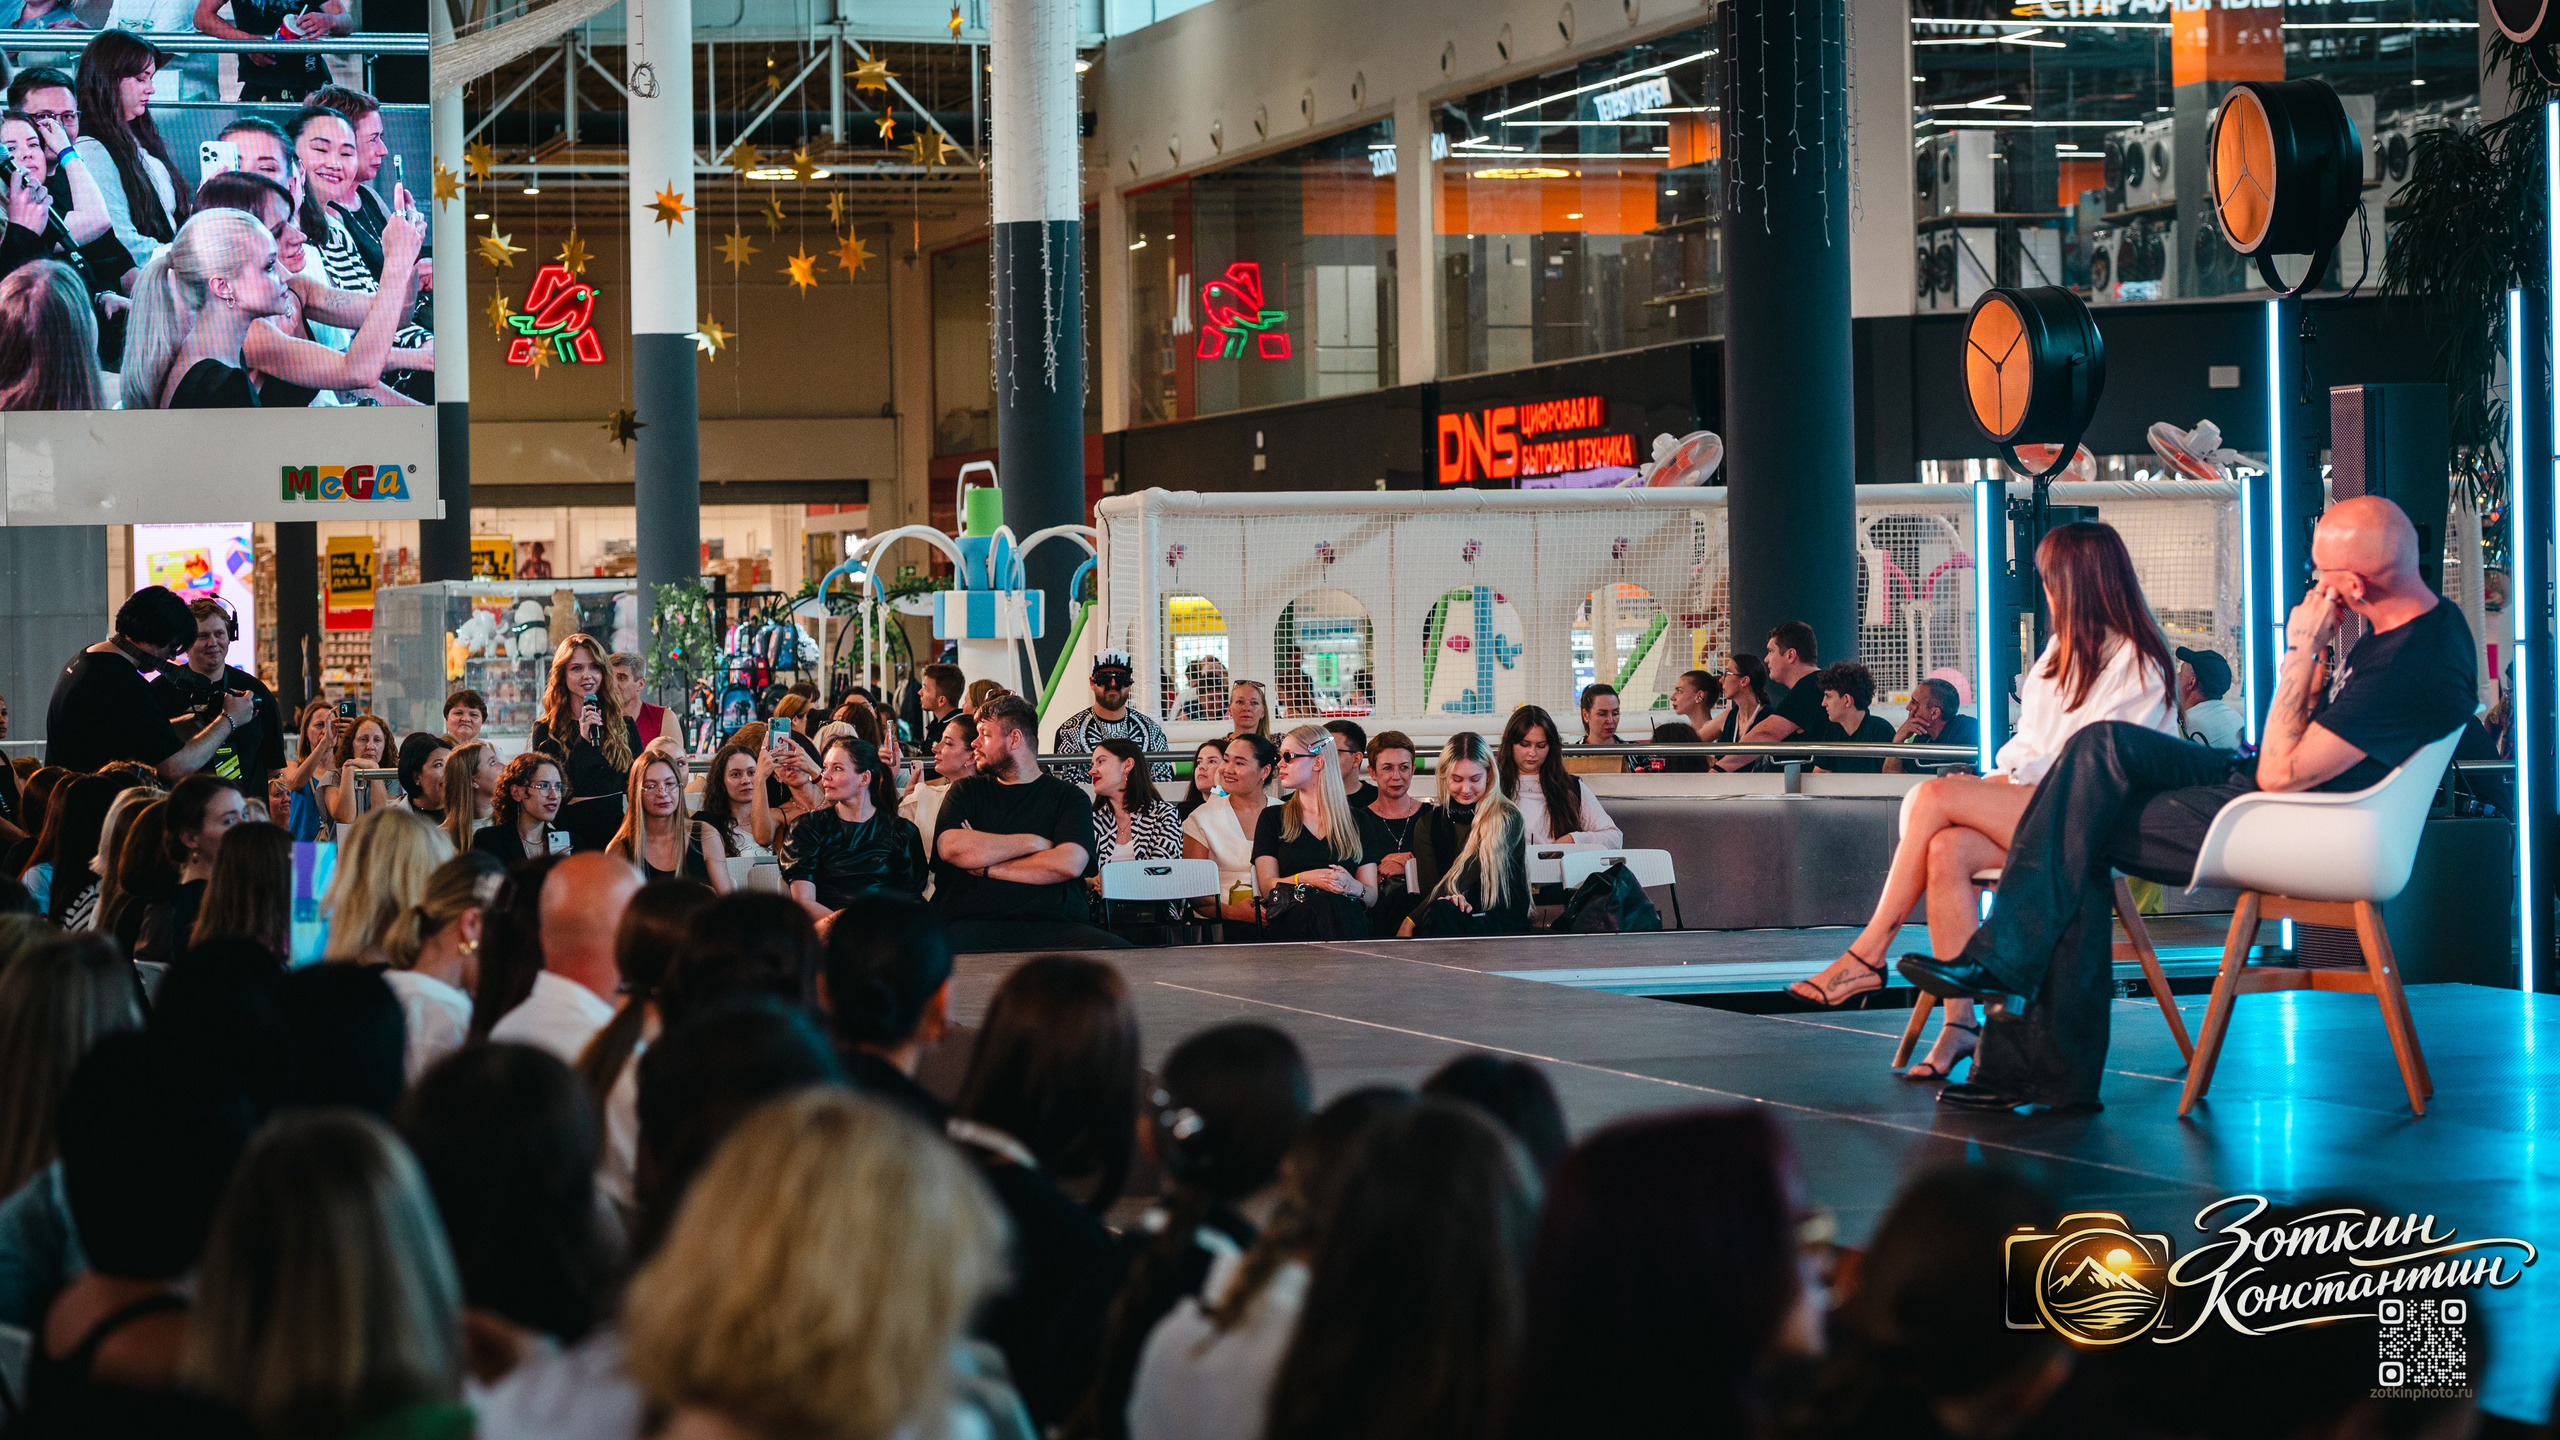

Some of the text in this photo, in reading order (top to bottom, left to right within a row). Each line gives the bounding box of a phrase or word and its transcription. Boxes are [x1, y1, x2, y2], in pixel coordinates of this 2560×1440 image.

[1520, 396, 1599, 438] ЦИФРОВАЯ И
[1438, 406, 1519, 484] DNS
[1521, 434, 1632, 475] БЫТОВАЯ ТЕХНИКА
